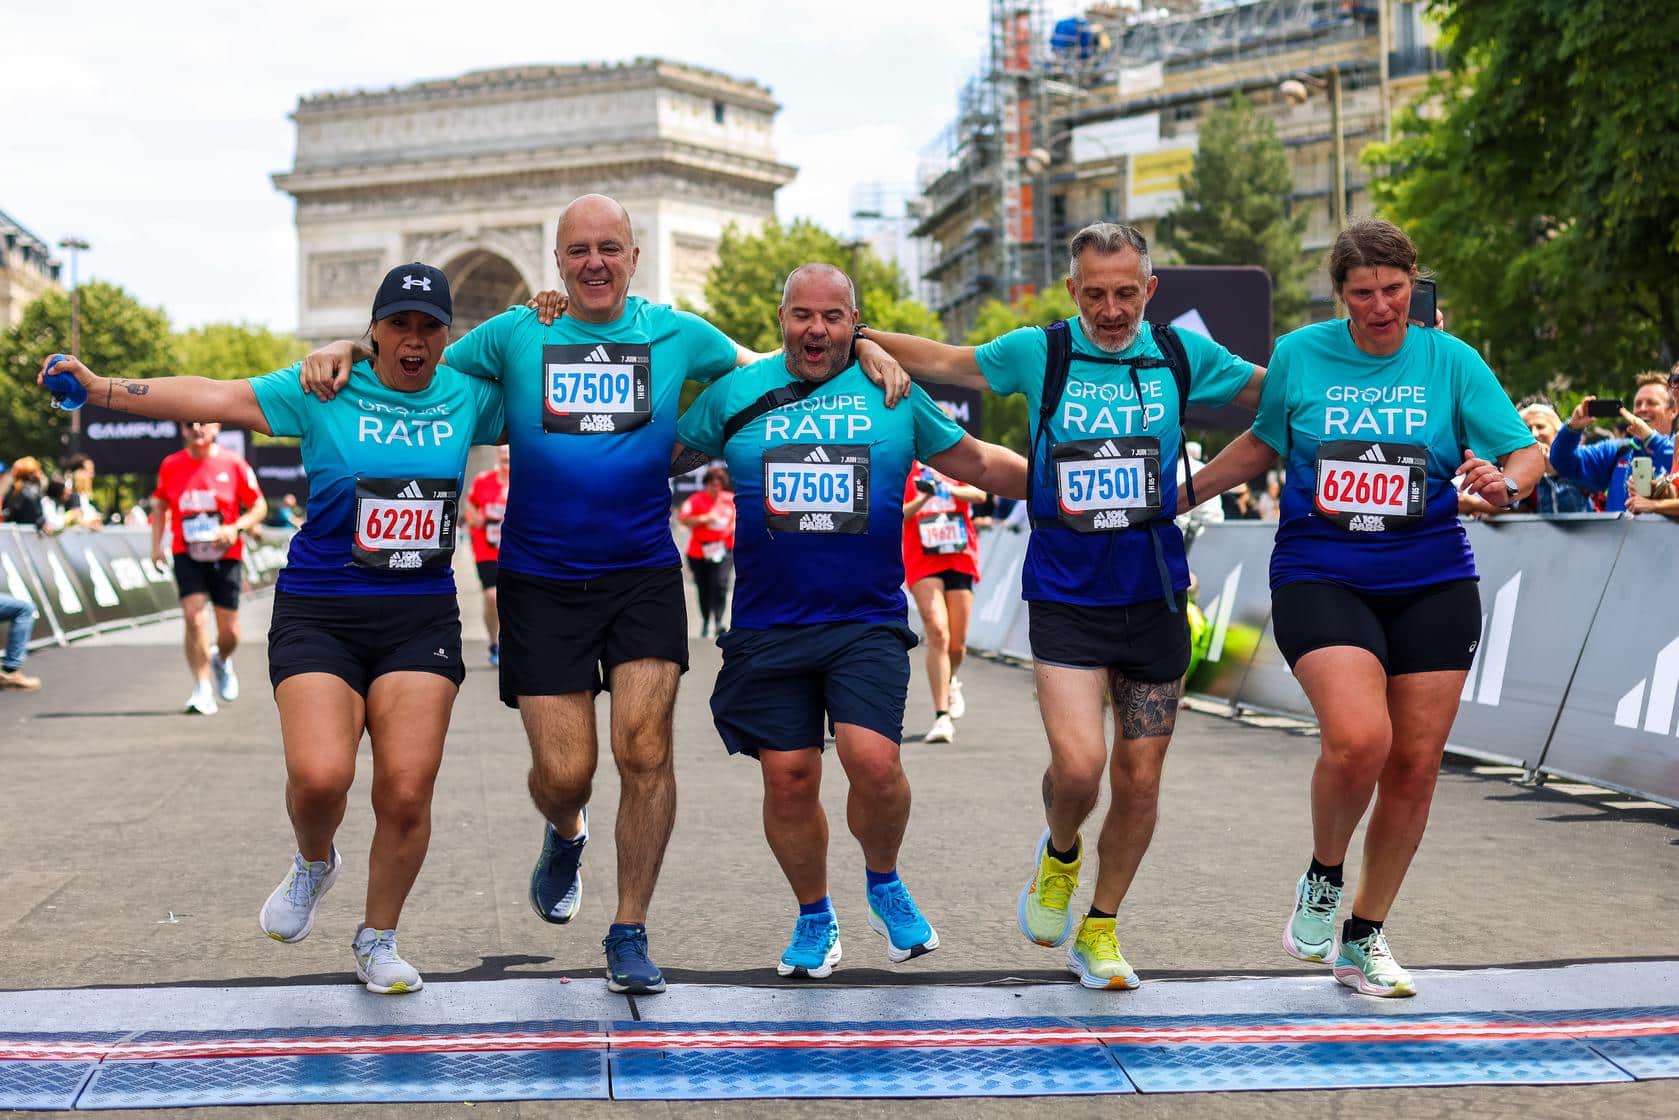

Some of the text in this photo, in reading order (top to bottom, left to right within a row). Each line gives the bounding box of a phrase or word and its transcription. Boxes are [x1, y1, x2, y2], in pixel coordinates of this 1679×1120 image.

[552, 373, 630, 404] 57509
[1066, 380, 1163, 403] GROUPE
[1326, 386, 1427, 404] GROUPE
[767, 395, 868, 413] ROUPE
[87, 421, 178, 440] CAMPUS
[580, 421, 615, 431] PARIS
[765, 414, 872, 440] RATP
[1063, 402, 1165, 435] RATP
[1324, 407, 1428, 435] RATP
[359, 416, 453, 447] RATP
[772, 472, 850, 503] 57503
[1068, 467, 1139, 502] 57501
[1323, 470, 1405, 506] 62602
[366, 508, 435, 540] 62216
[800, 521, 834, 531] PARIS
[1094, 519, 1129, 529] PARIS
[1349, 522, 1385, 532] PARIS
[389, 559, 422, 568] PARIS
